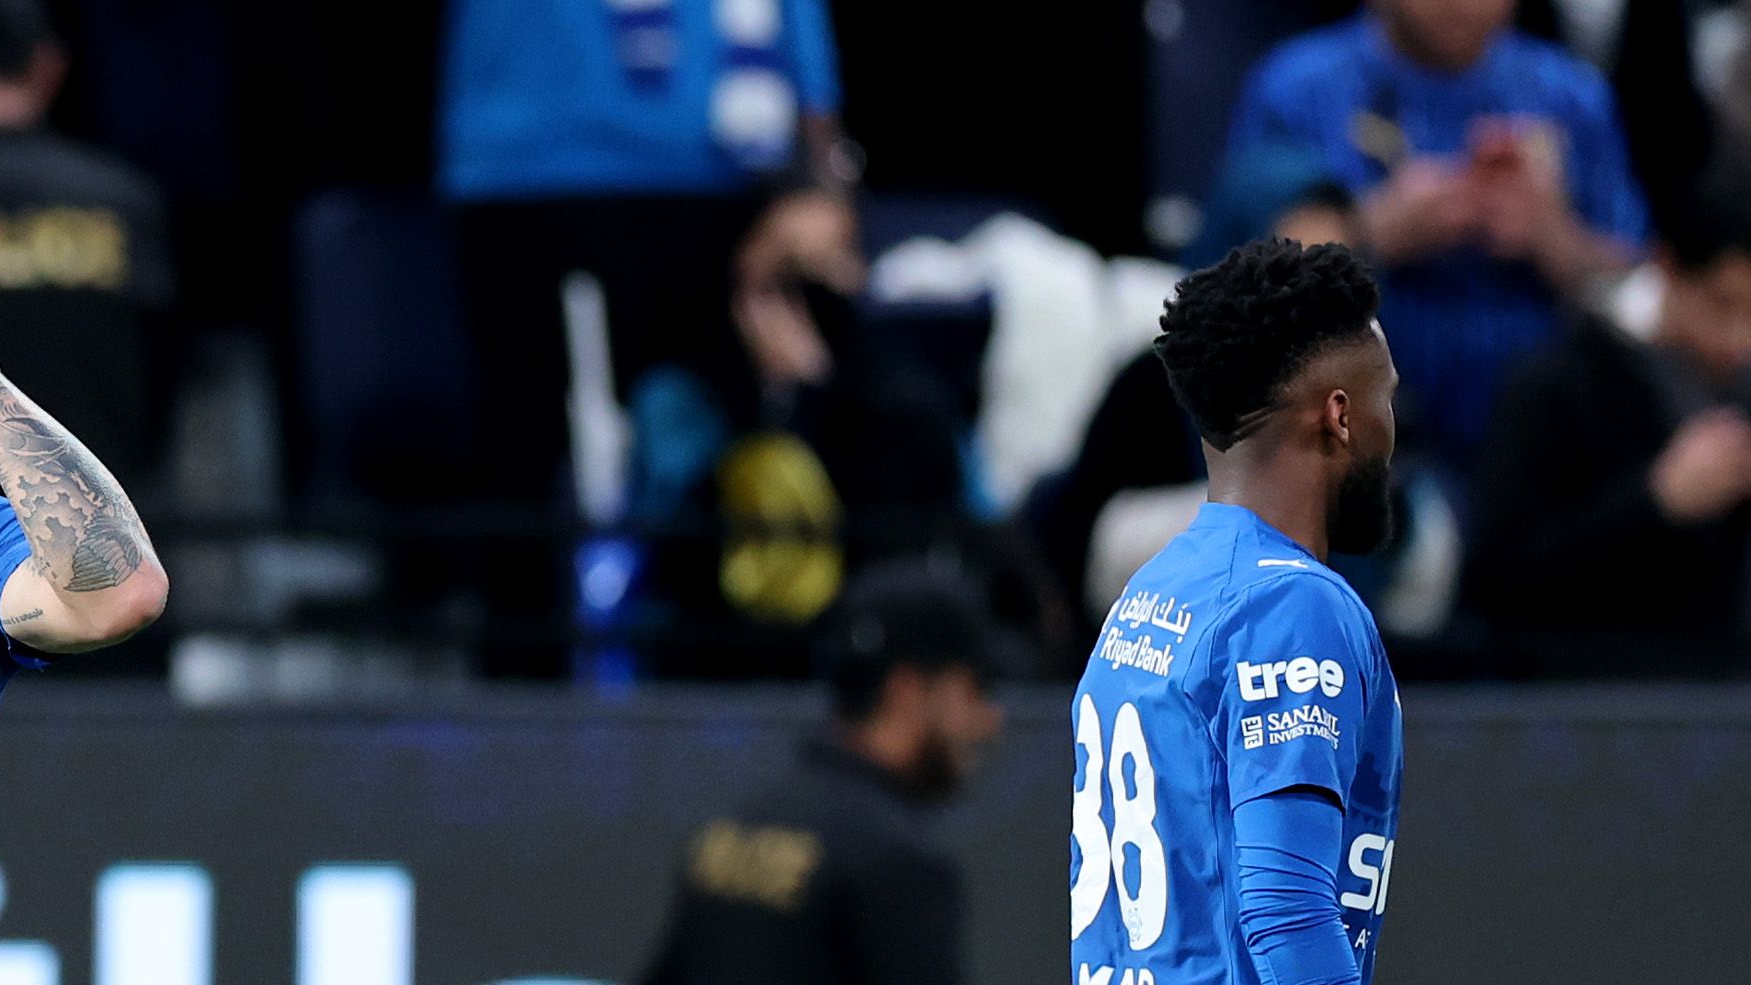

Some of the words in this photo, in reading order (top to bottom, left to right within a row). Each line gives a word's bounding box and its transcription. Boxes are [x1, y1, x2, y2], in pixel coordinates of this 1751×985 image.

[1099, 626, 1143, 670] Riyad
[1134, 635, 1174, 677] Bank
[1235, 656, 1345, 702] tree
